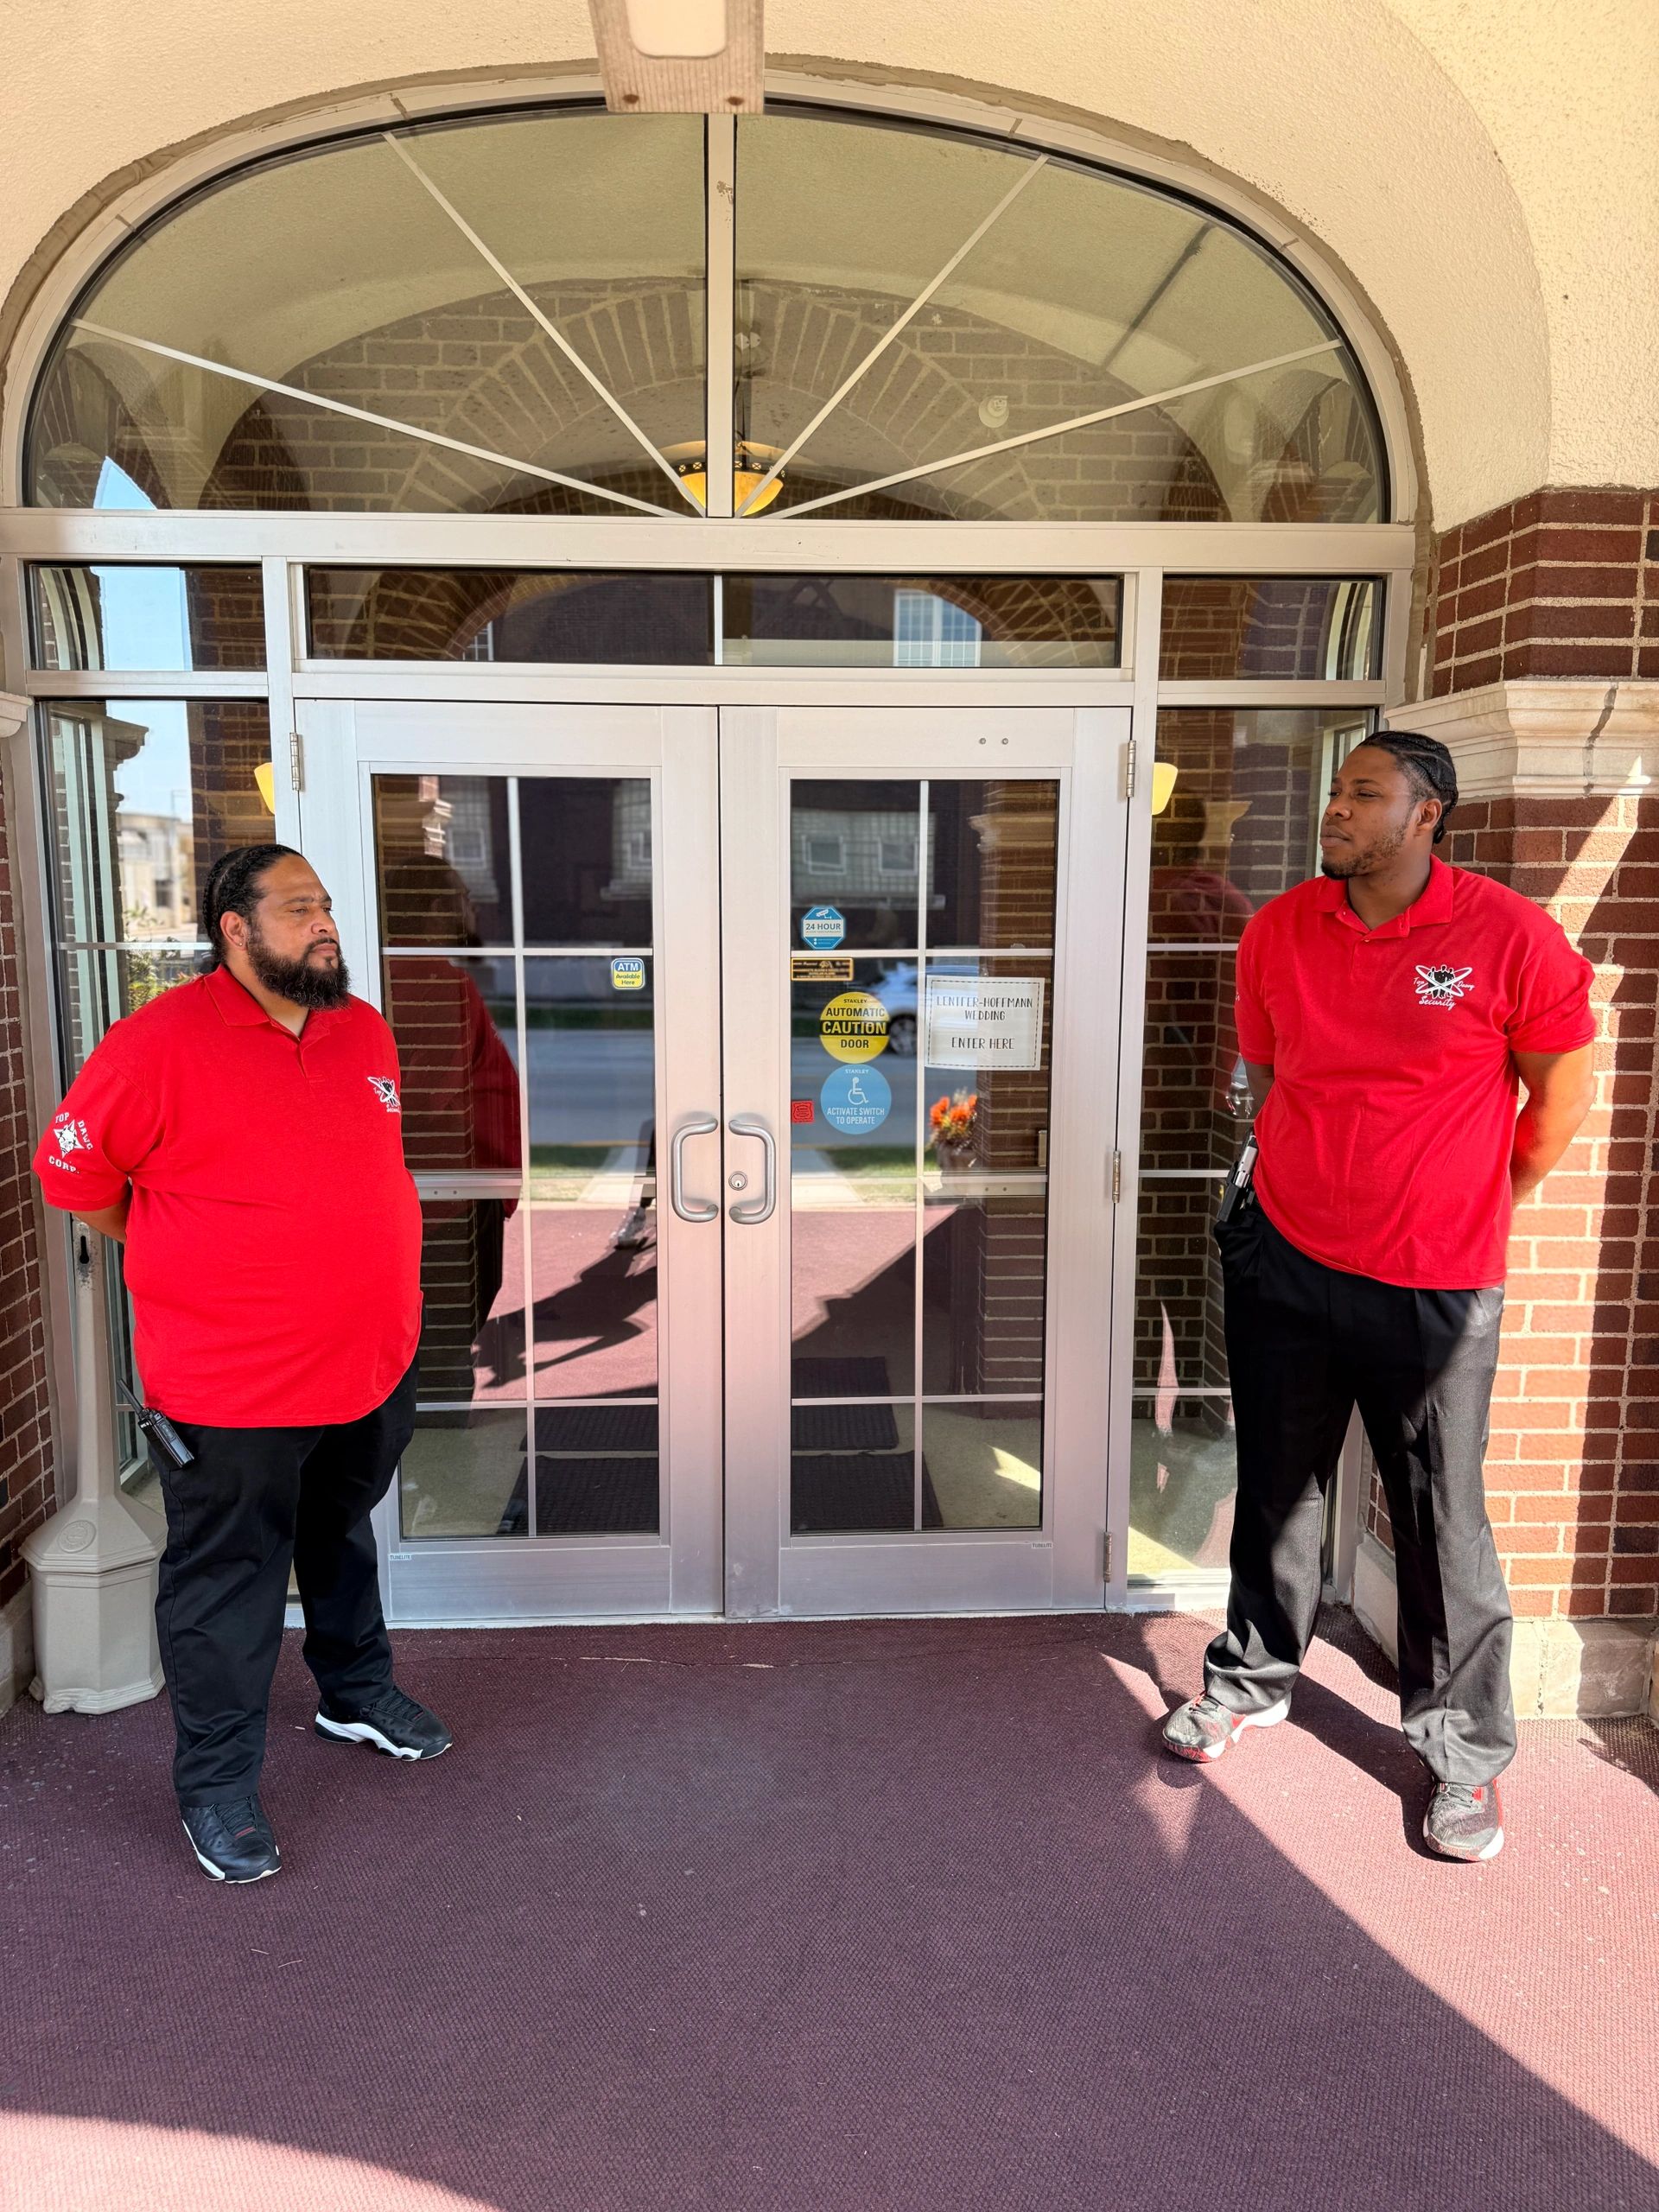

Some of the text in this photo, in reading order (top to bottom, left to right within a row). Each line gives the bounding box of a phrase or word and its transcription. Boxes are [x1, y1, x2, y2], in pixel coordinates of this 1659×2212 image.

[617, 963, 639, 971] ATM
[1418, 995, 1456, 1011] Security
[825, 1007, 886, 1017] AUTOMATIC
[964, 1009, 1006, 1020] WEDDING
[822, 1021, 887, 1034] CAUTION
[840, 1039, 869, 1048] DOOR
[951, 1037, 1015, 1050] ENTER HERE
[827, 1107, 885, 1116] ACTIVATE SWITCH
[836, 1116, 875, 1125] TO OPERATE
[55, 1111, 94, 1151] TOP DAWG
